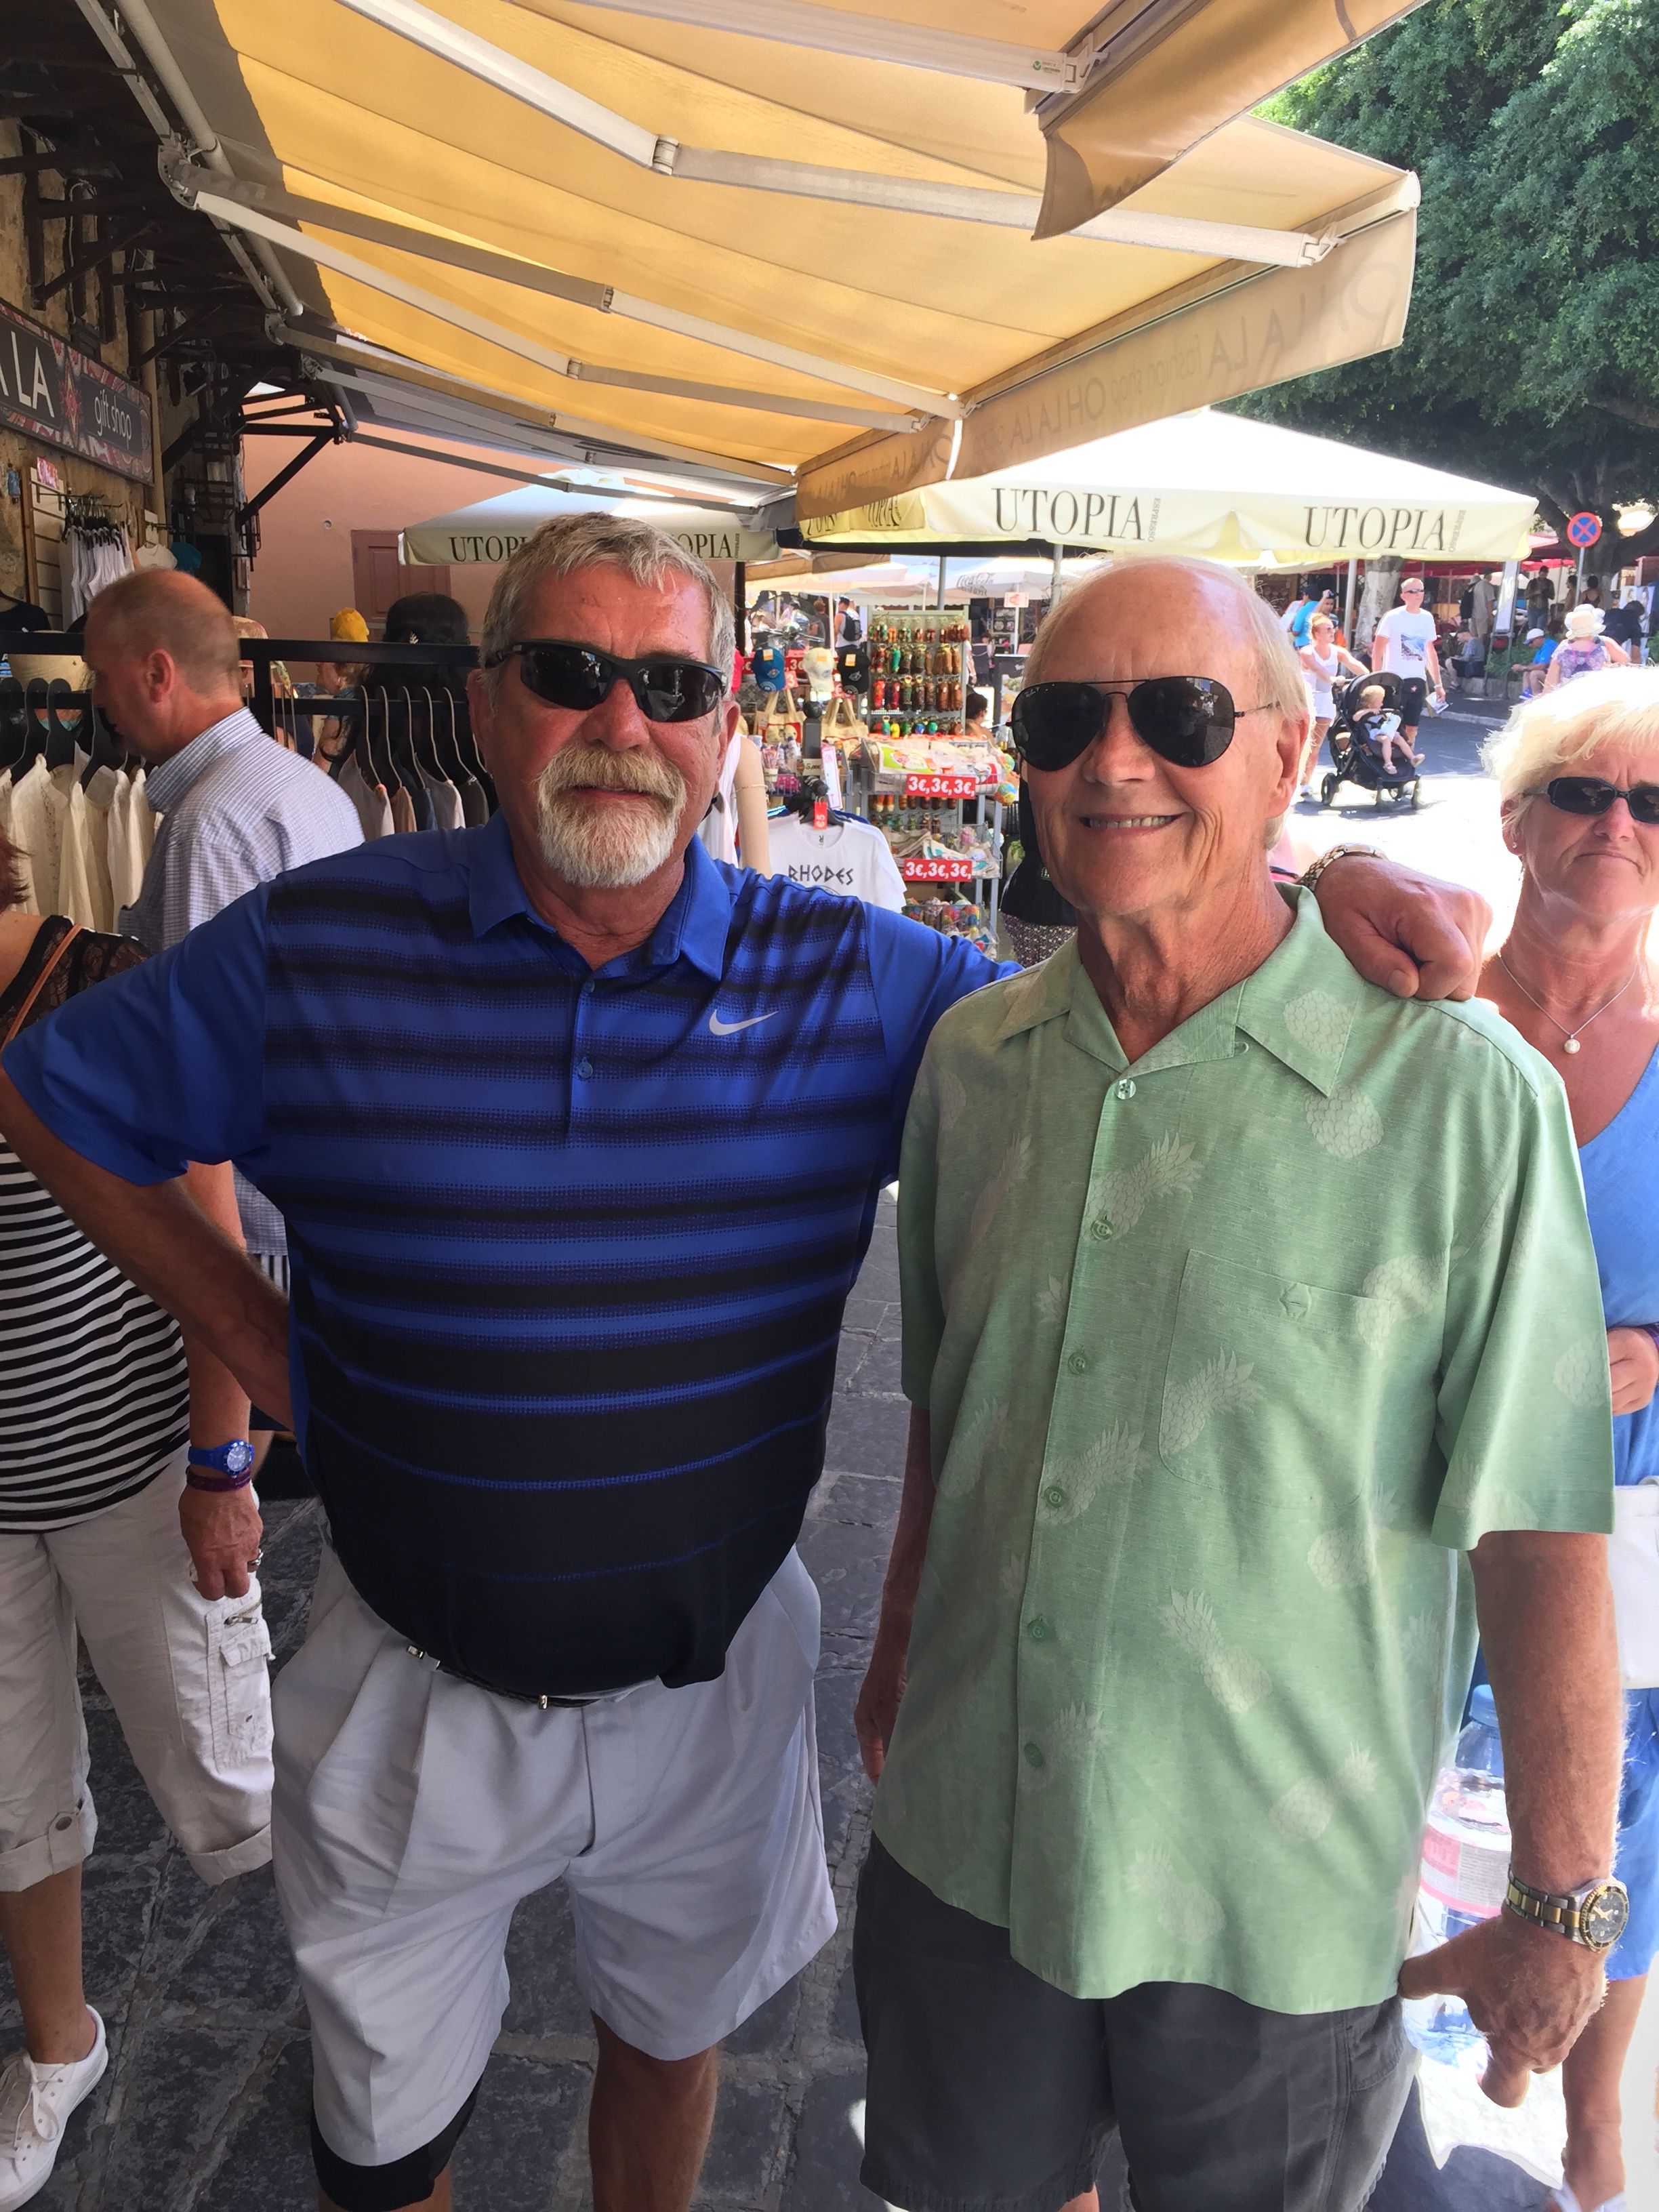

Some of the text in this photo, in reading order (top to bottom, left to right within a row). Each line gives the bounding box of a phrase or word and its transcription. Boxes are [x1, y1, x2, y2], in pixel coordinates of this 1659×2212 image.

[11, 330, 56, 418] LA
[94, 388, 132, 451] gift shop
[991, 488, 1145, 541] UTOPIA
[1149, 497, 1161, 542] ESPRESSO
[1303, 506, 1445, 551] UTOPIA
[789, 865, 853, 885] RHODES
